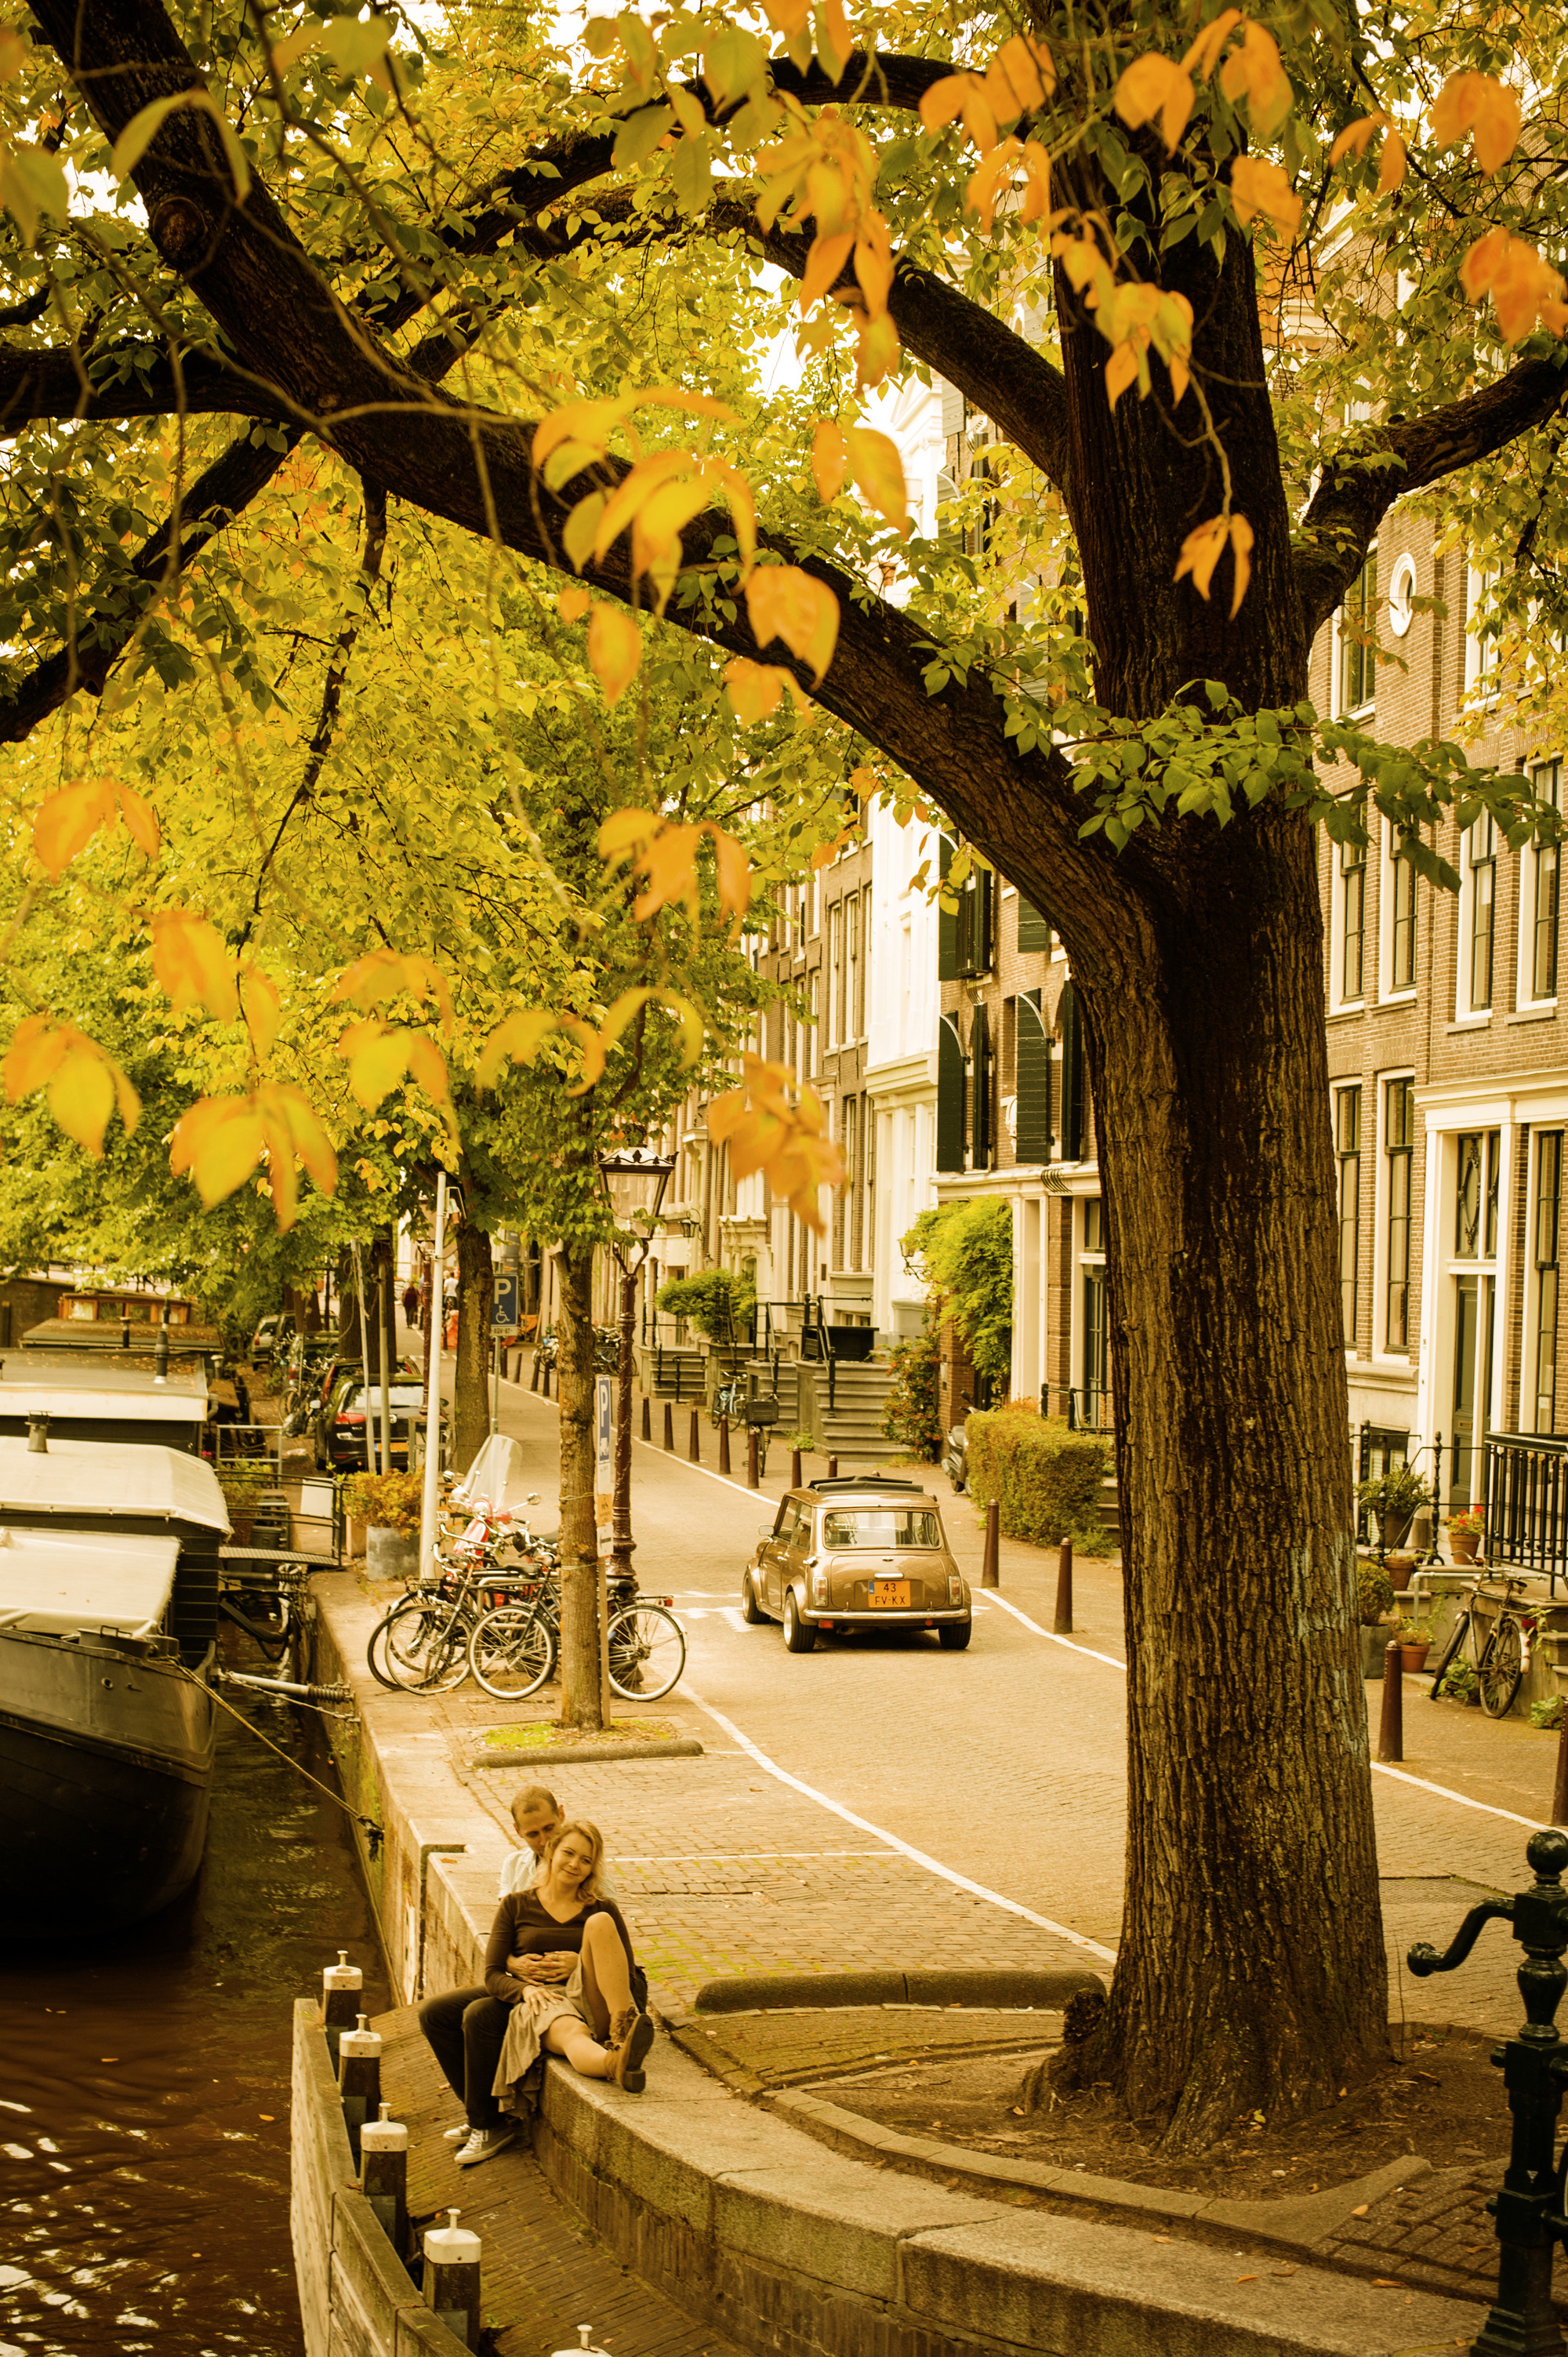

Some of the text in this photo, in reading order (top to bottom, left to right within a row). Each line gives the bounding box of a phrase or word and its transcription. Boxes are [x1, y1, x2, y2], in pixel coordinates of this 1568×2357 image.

[494, 1278, 512, 1305] P
[600, 1384, 608, 1428] P
[883, 1582, 897, 1593] 43
[875, 1596, 906, 1605] FV-KX
